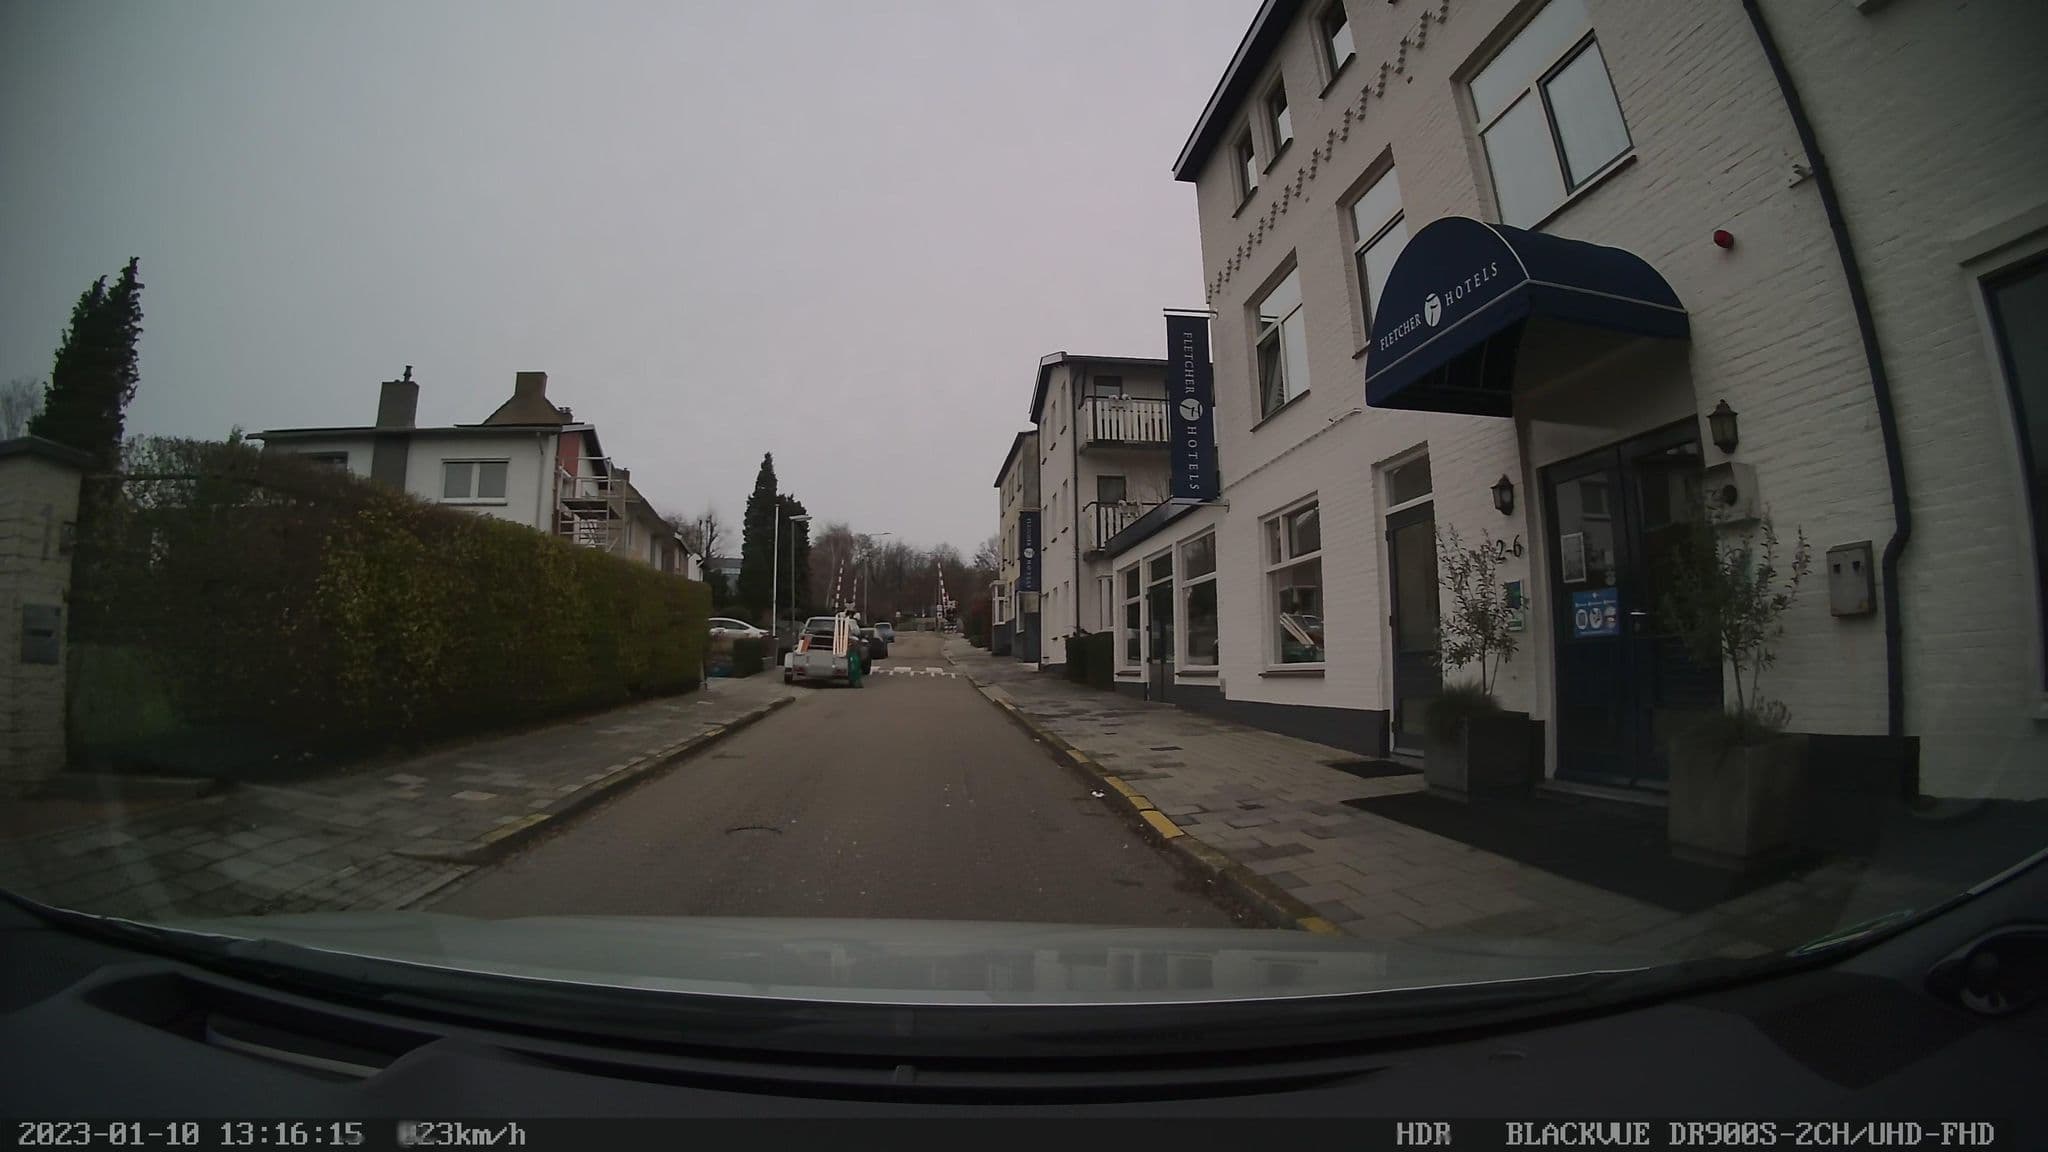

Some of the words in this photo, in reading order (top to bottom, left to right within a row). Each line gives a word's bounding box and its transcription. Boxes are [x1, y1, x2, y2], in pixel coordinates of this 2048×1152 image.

[1380, 313, 1422, 351] FLETCHER
[1444, 262, 1498, 306] HOTELS
[1183, 332, 1195, 394] FLETCHER
[1187, 426, 1200, 490] HOTELS
[1495, 534, 1523, 562] 2-6
